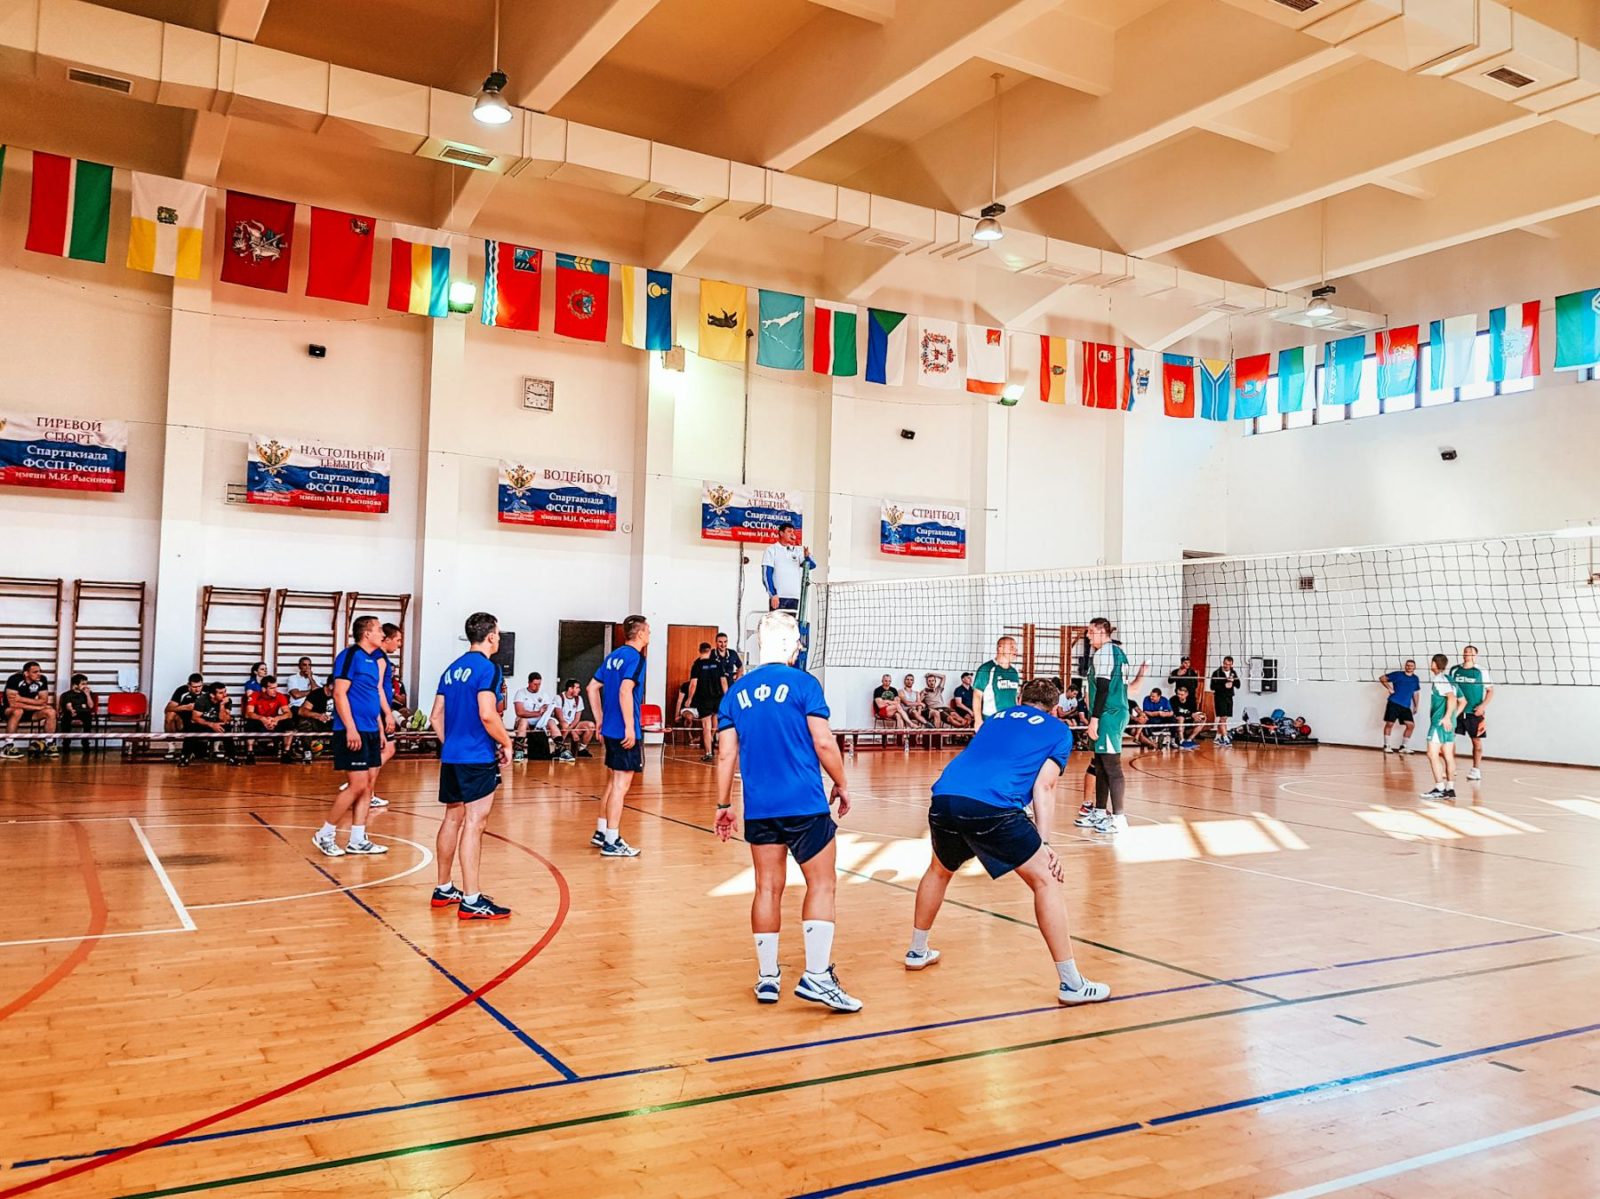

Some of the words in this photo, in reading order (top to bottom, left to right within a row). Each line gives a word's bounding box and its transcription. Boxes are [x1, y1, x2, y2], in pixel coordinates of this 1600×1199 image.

[37, 416, 102, 432] ГИРЕВОЙ
[44, 431, 93, 444] СПОРТ
[26, 445, 108, 460] Спартакиада
[300, 444, 385, 462] НАСТОЛЬНЫЙ
[23, 458, 64, 470] ФССП
[68, 461, 111, 474] России
[16, 472, 46, 480] имени
[309, 470, 374, 484] Спартакиада
[544, 469, 611, 486] ВОЛЕЙБОЛ
[306, 482, 340, 493] ФССП
[342, 485, 377, 496] России
[754, 490, 786, 500] ЛЕГКАЯ
[549, 492, 604, 506] Спартакиада
[546, 503, 574, 514] ФССП
[576, 506, 606, 516] России
[745, 510, 792, 522] Спартакиада
[912, 508, 960, 520] СТРИТБОЛ
[742, 520, 767, 530] ФССП
[768, 522, 780, 530] Рос
[736, 684, 789, 710] ЦФО
